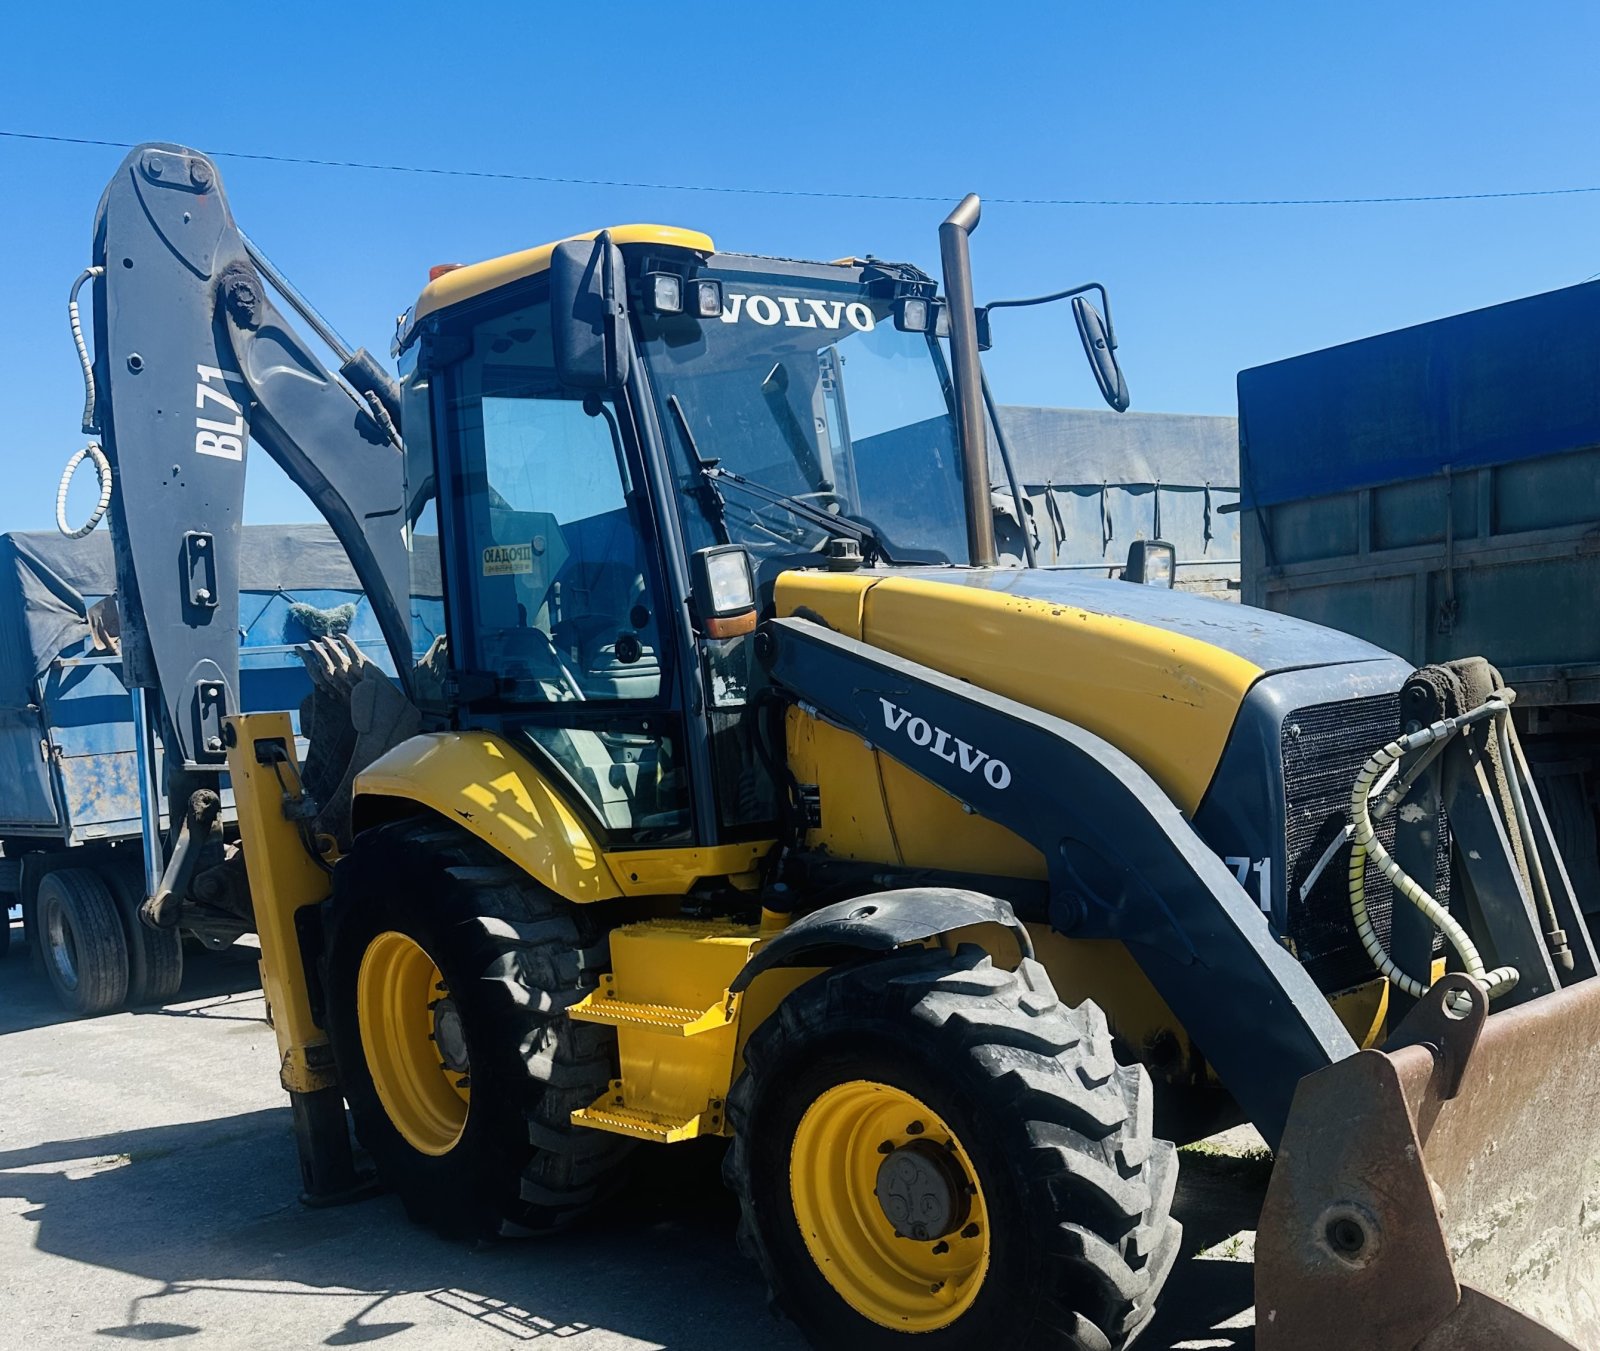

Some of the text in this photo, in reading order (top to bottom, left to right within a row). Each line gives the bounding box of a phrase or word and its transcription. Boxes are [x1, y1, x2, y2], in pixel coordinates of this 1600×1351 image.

[720, 294, 875, 332] VOLVO
[195, 364, 243, 461] BL71
[879, 697, 1011, 789] VOLVO
[1225, 856, 1271, 911] 71
